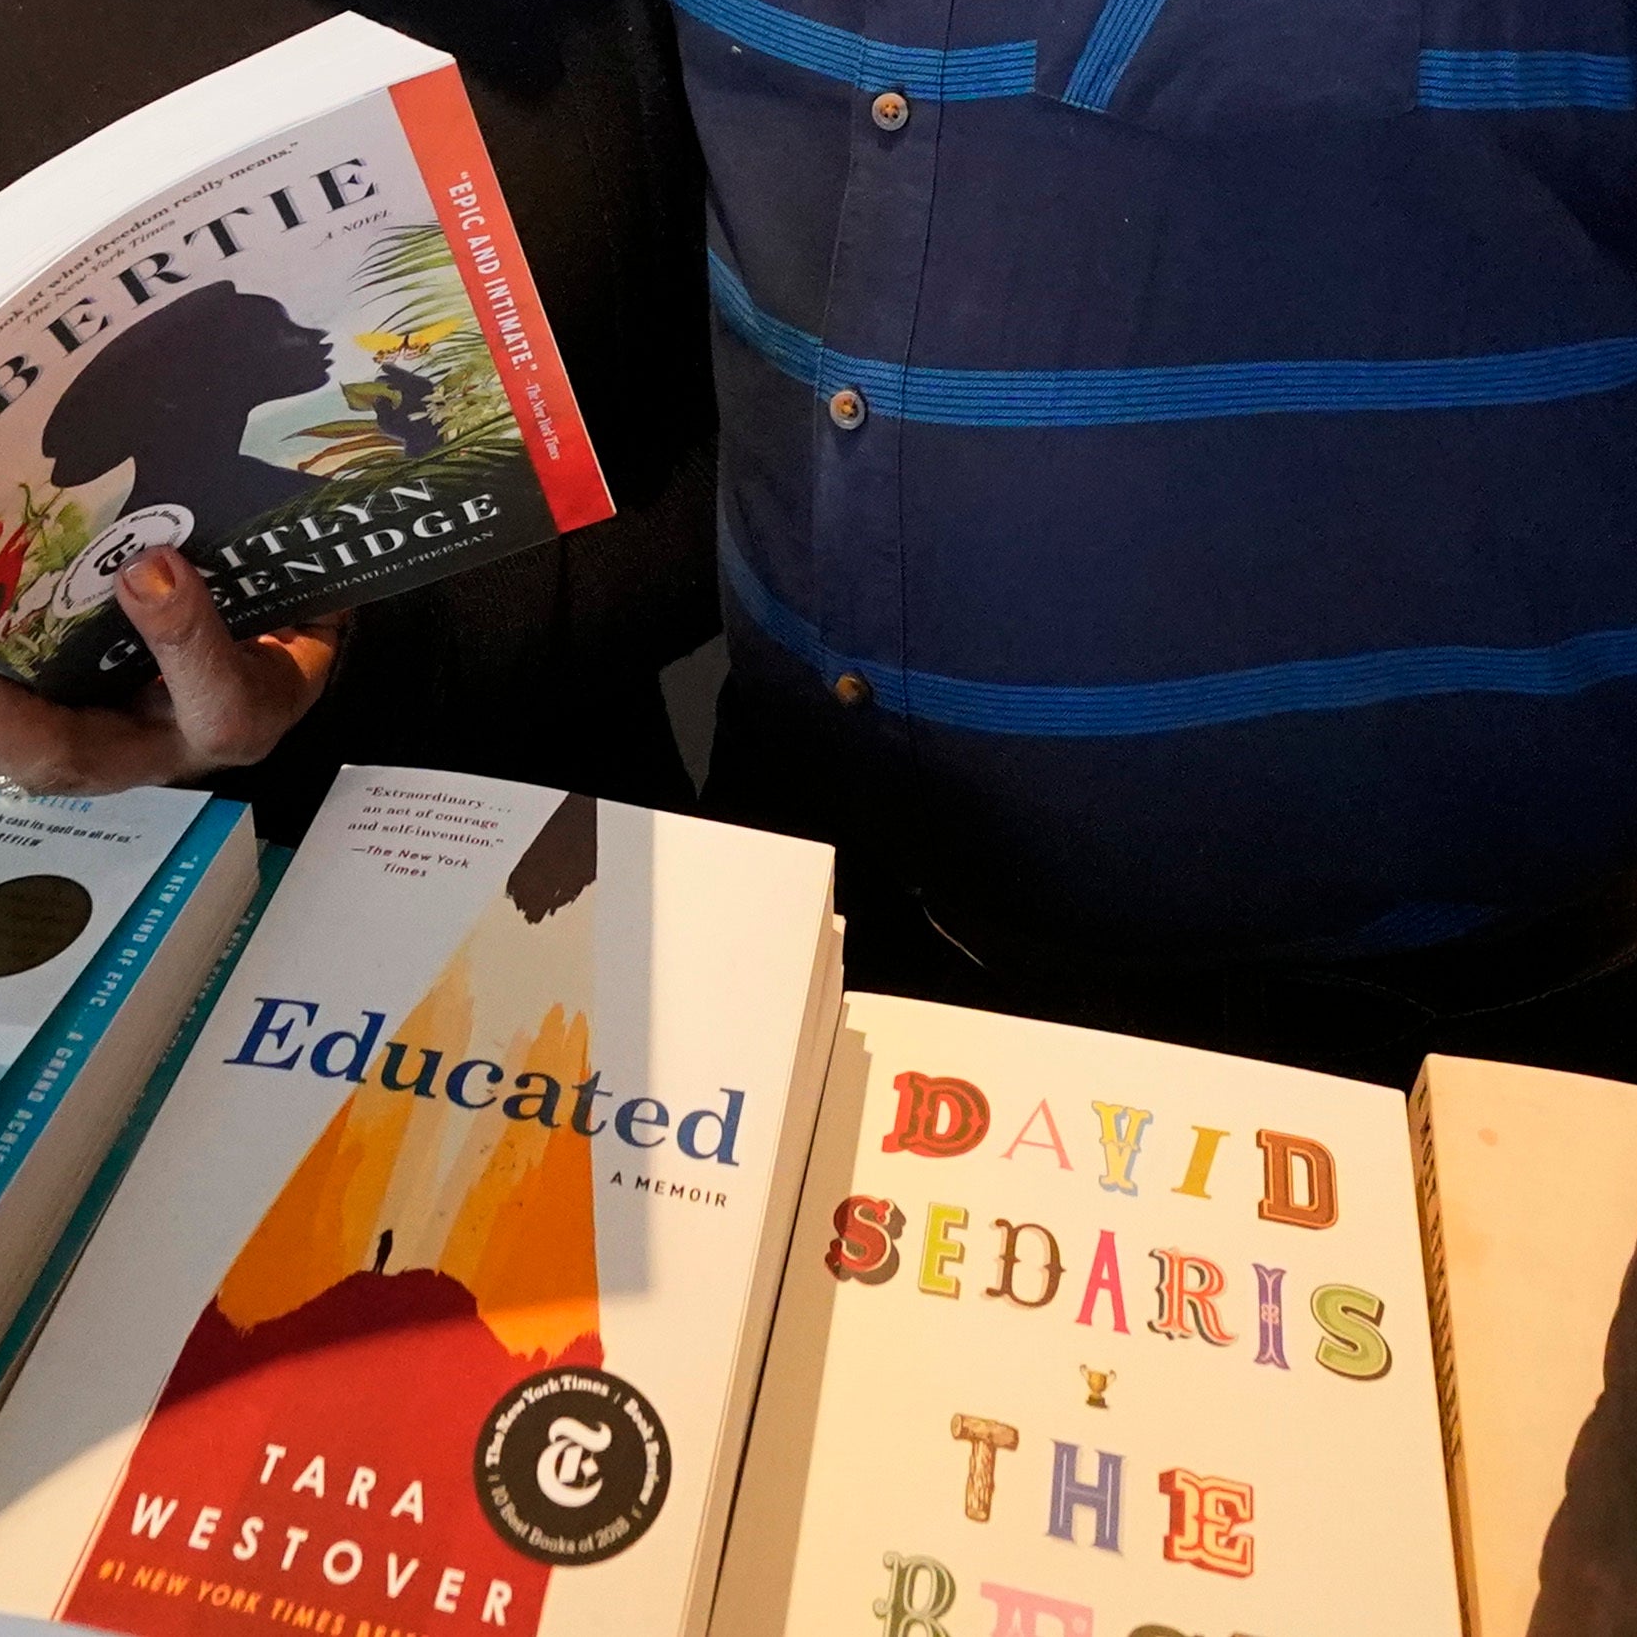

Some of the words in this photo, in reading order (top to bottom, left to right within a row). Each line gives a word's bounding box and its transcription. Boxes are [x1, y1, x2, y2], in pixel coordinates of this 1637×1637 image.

[94, 206, 170, 256] freedom
[172, 177, 224, 210] really
[341, 207, 393, 239] NOVEL
[435, 812, 499, 830] courage
[383, 863, 428, 877] Times
[224, 994, 747, 1171] Educated
[880, 1069, 1340, 1232] DAVID
[635, 1174, 731, 1210] MEMOIR
[824, 1193, 1395, 1382] SEDARIS
[560, 1374, 610, 1397] Times
[258, 1442, 425, 1525] TARA
[949, 1411, 1258, 1579] THE
[129, 1492, 516, 1627] WESTOVER
[200, 1576, 261, 1613] YORK
